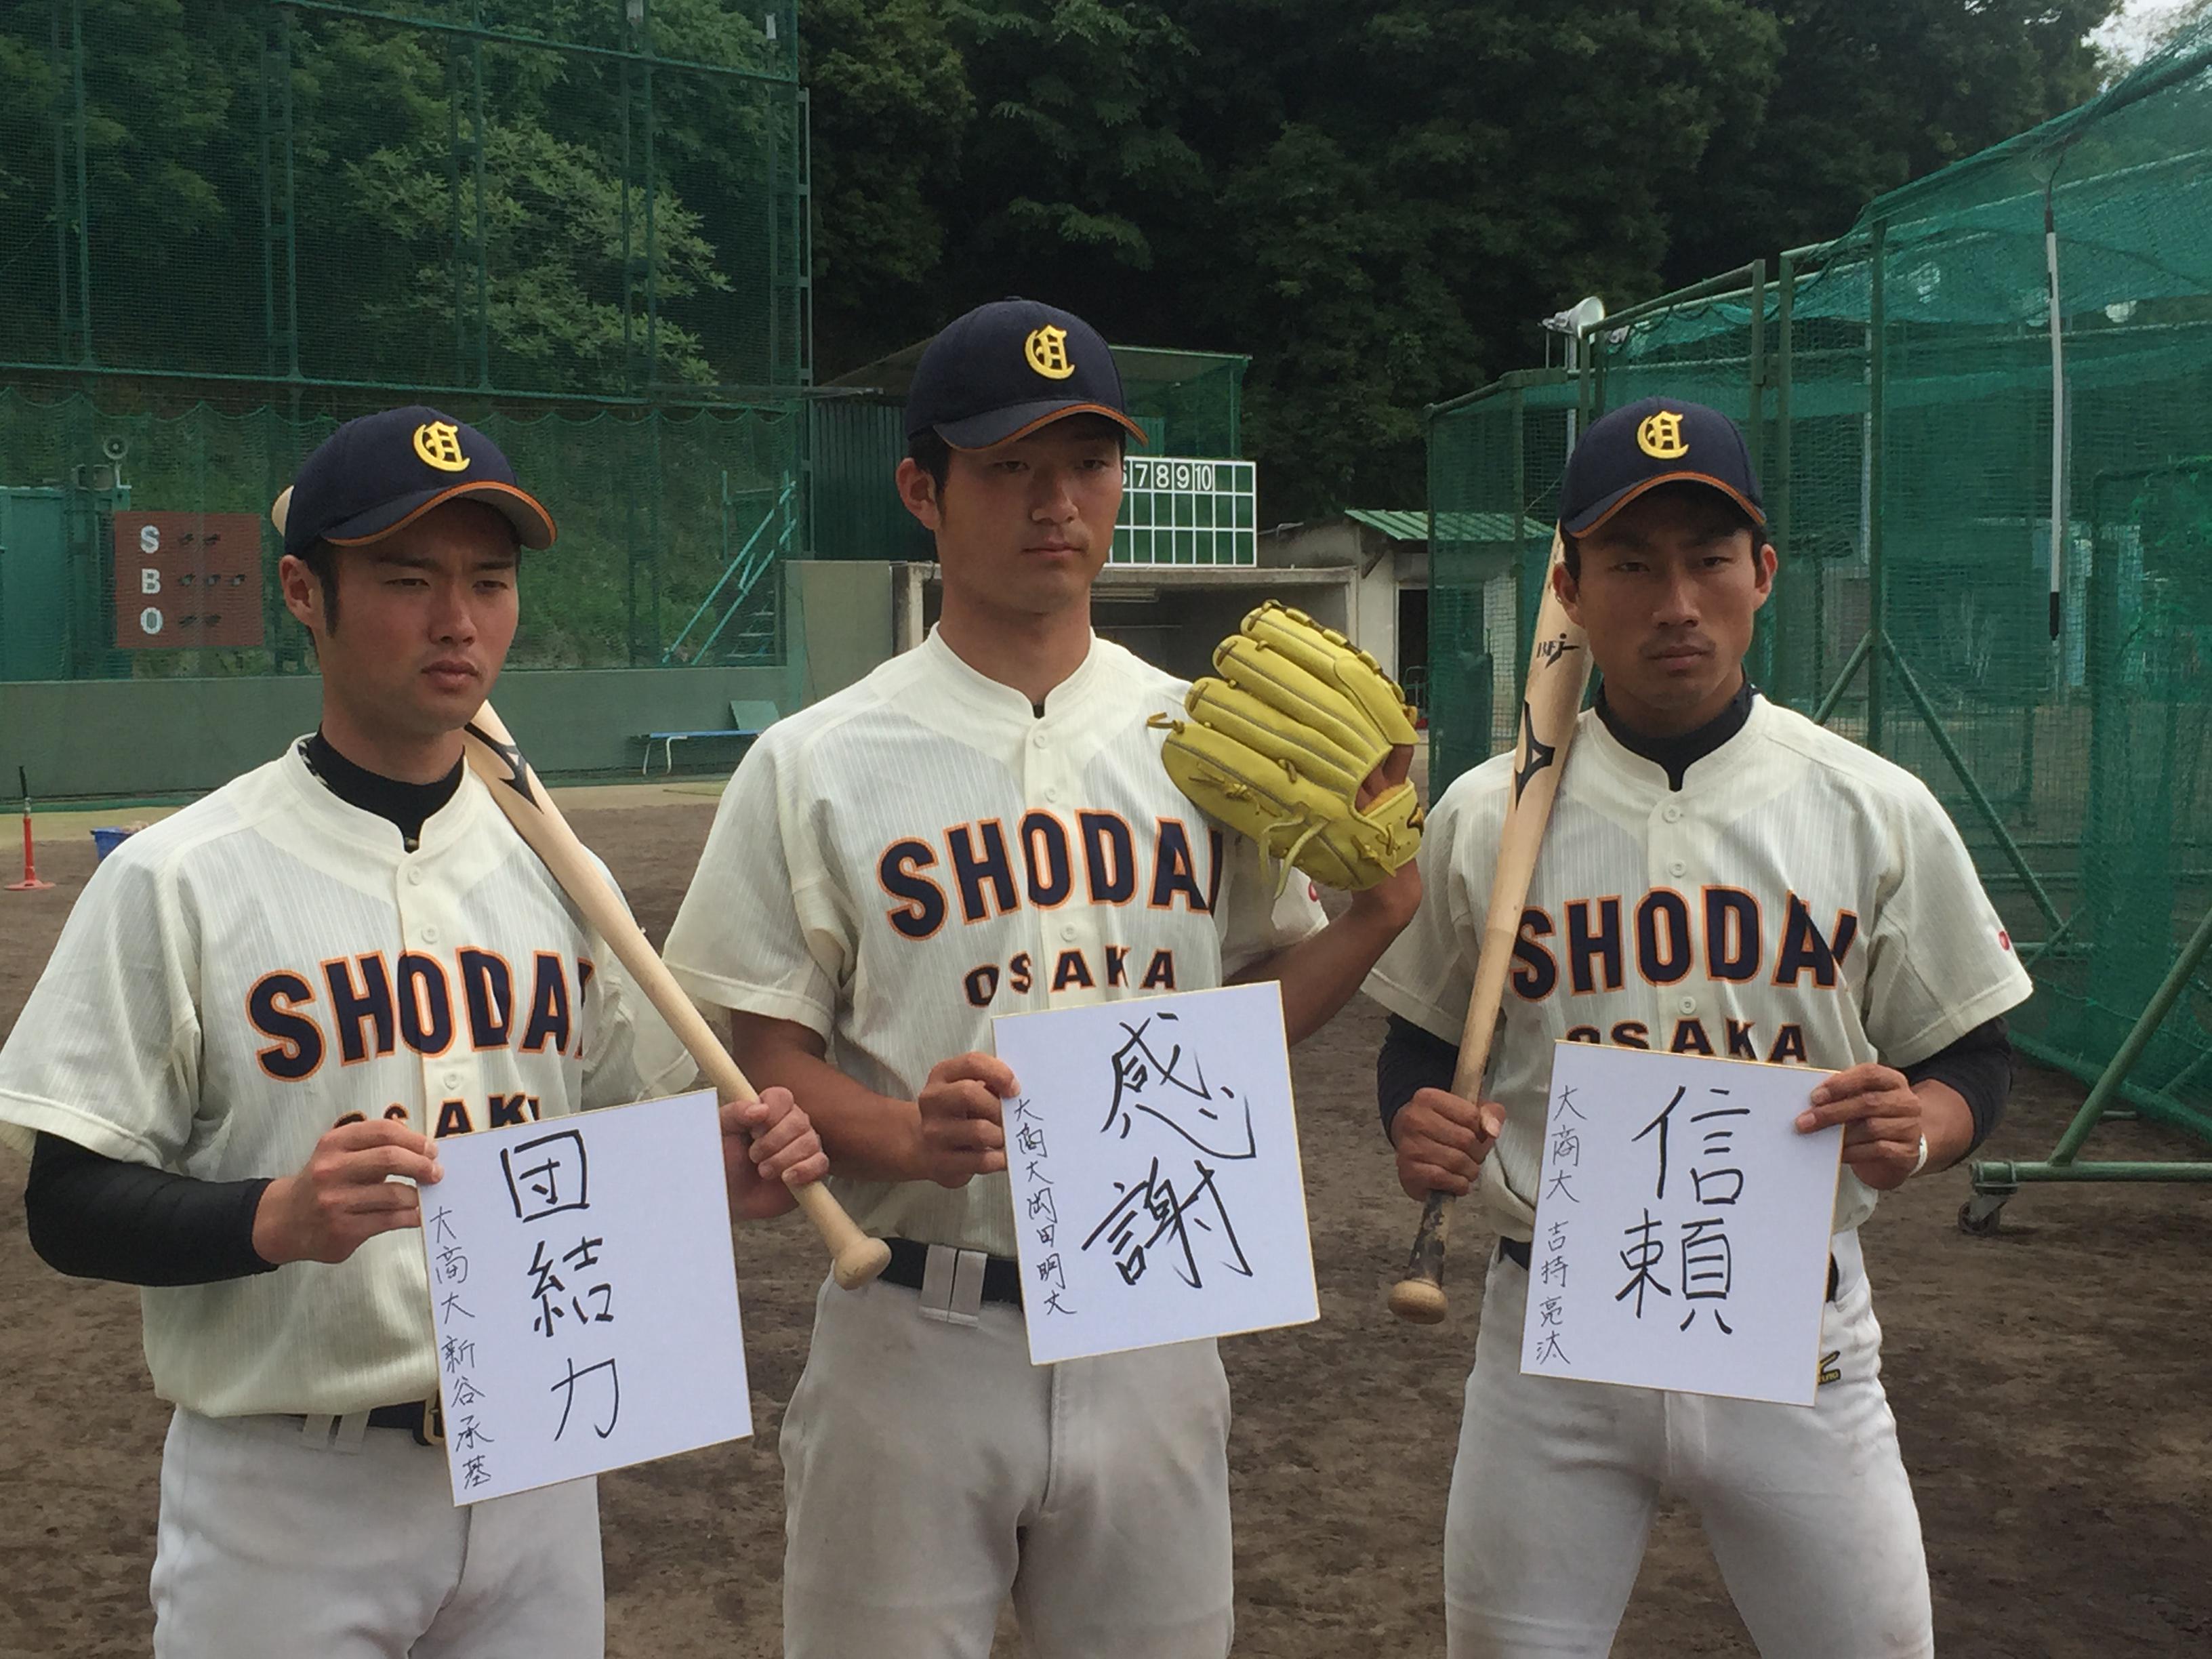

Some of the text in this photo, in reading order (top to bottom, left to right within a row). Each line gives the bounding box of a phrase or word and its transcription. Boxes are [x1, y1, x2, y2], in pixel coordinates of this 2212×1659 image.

[1134, 464, 1148, 487] 7
[1155, 464, 1170, 489] 8
[1176, 465, 1190, 489] 9
[1195, 465, 1212, 491] 10
[140, 525, 160, 554] S
[142, 568, 161, 594] B
[140, 607, 163, 634] O
[963, 945, 1176, 1008] OSAKA
[1082, 1012, 1257, 1289] 感謝
[1615, 1086, 1751, 1335] 信頼
[500, 1129, 619, 1442] 団結力
